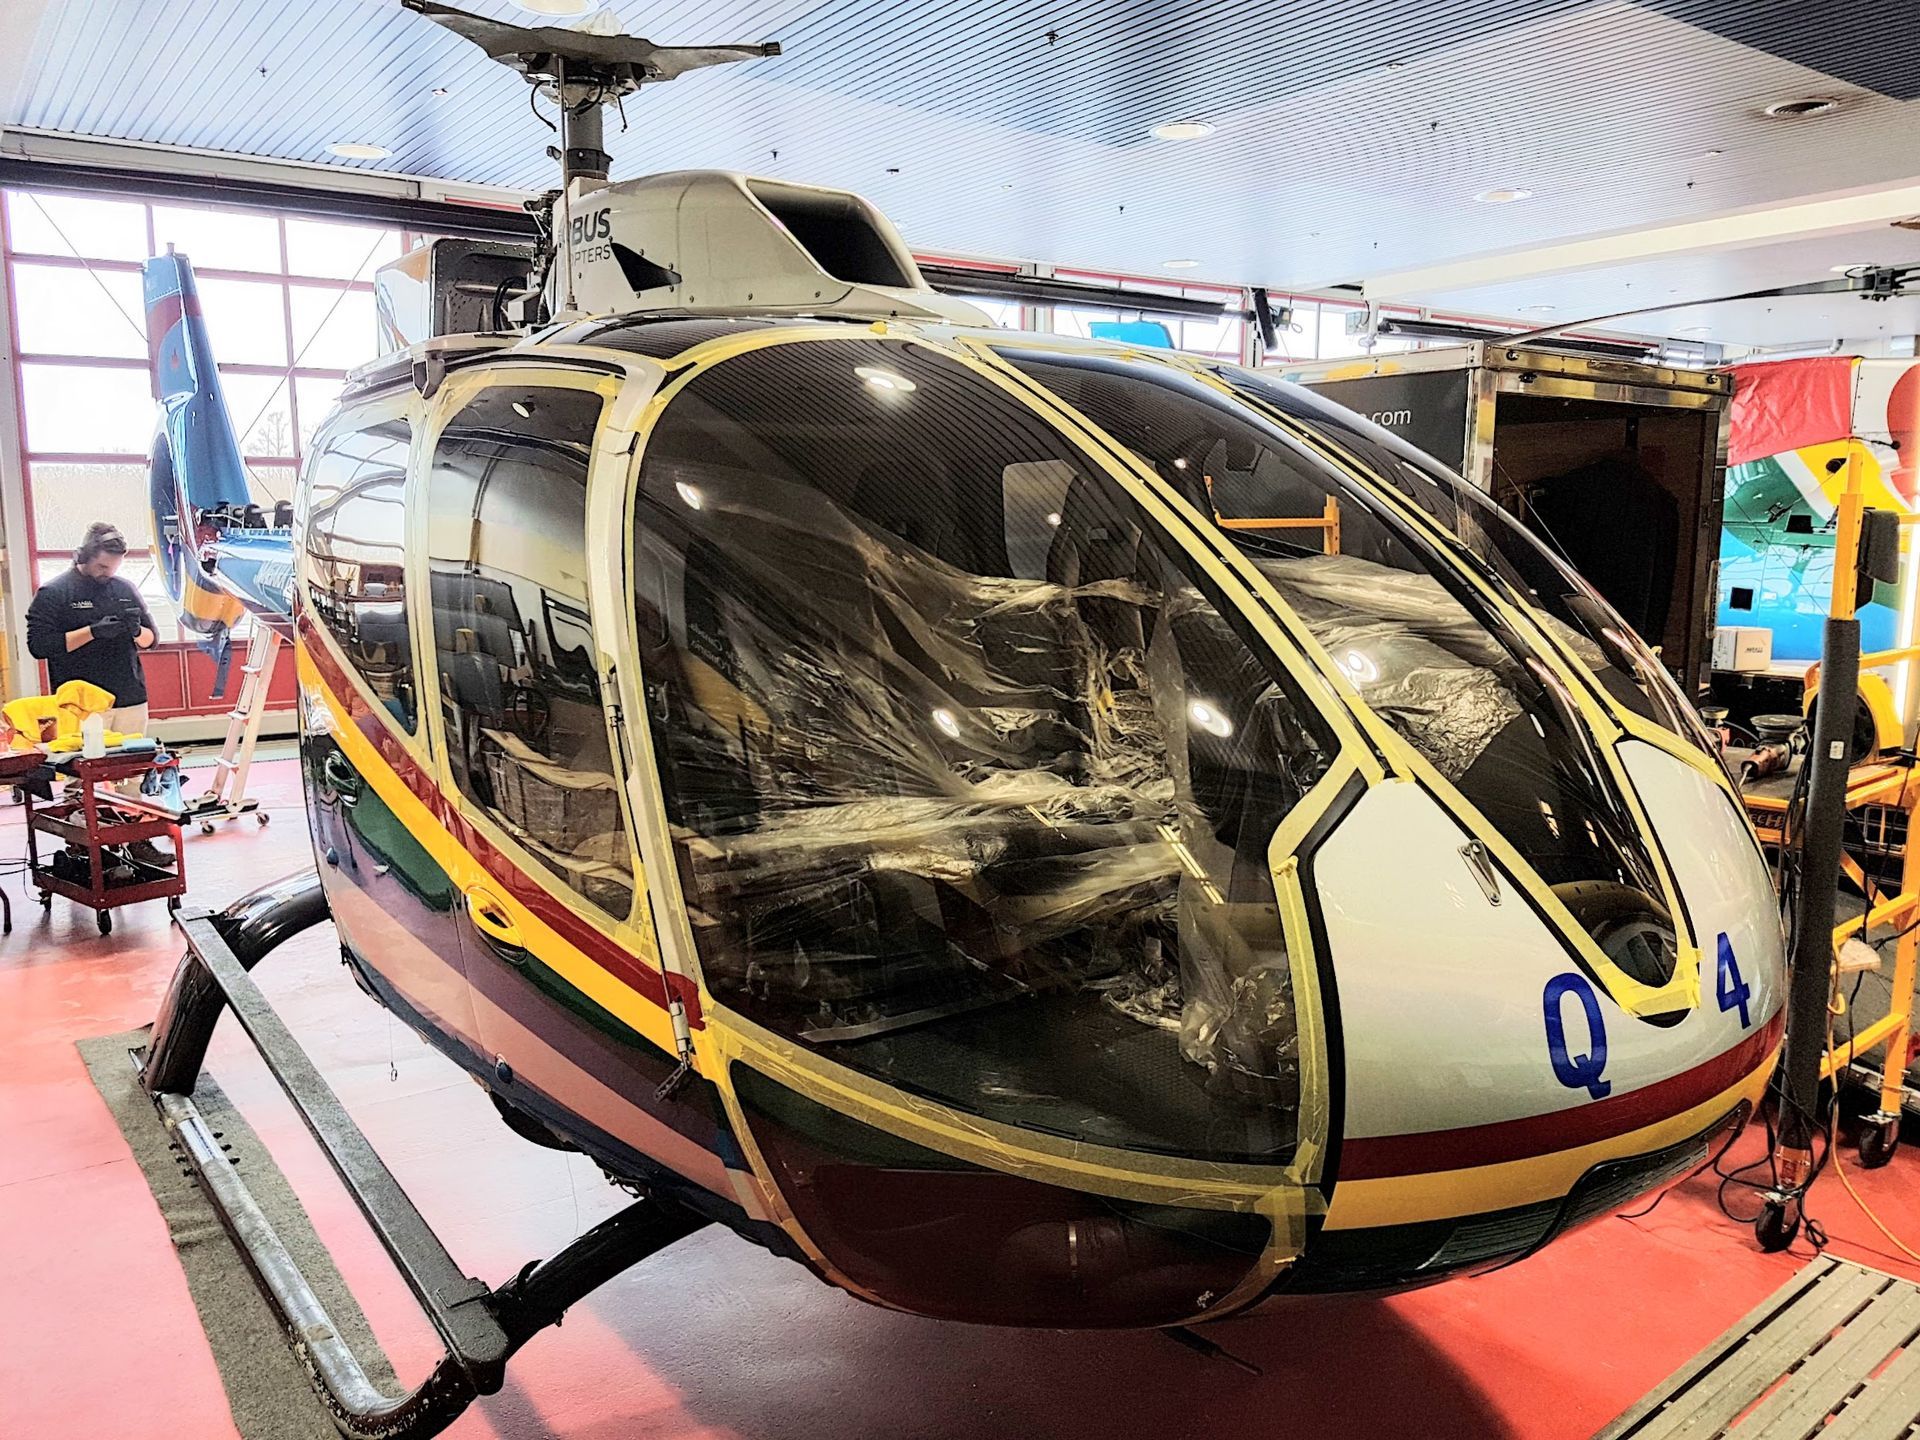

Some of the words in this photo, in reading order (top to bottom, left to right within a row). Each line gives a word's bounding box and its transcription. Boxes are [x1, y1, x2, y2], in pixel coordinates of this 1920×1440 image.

[570, 208, 611, 246] BUS
[571, 244, 611, 266] PTERS
[1360, 410, 1411, 426] com
[1543, 972, 1611, 1100] Q
[1716, 931, 1751, 1030] 4
